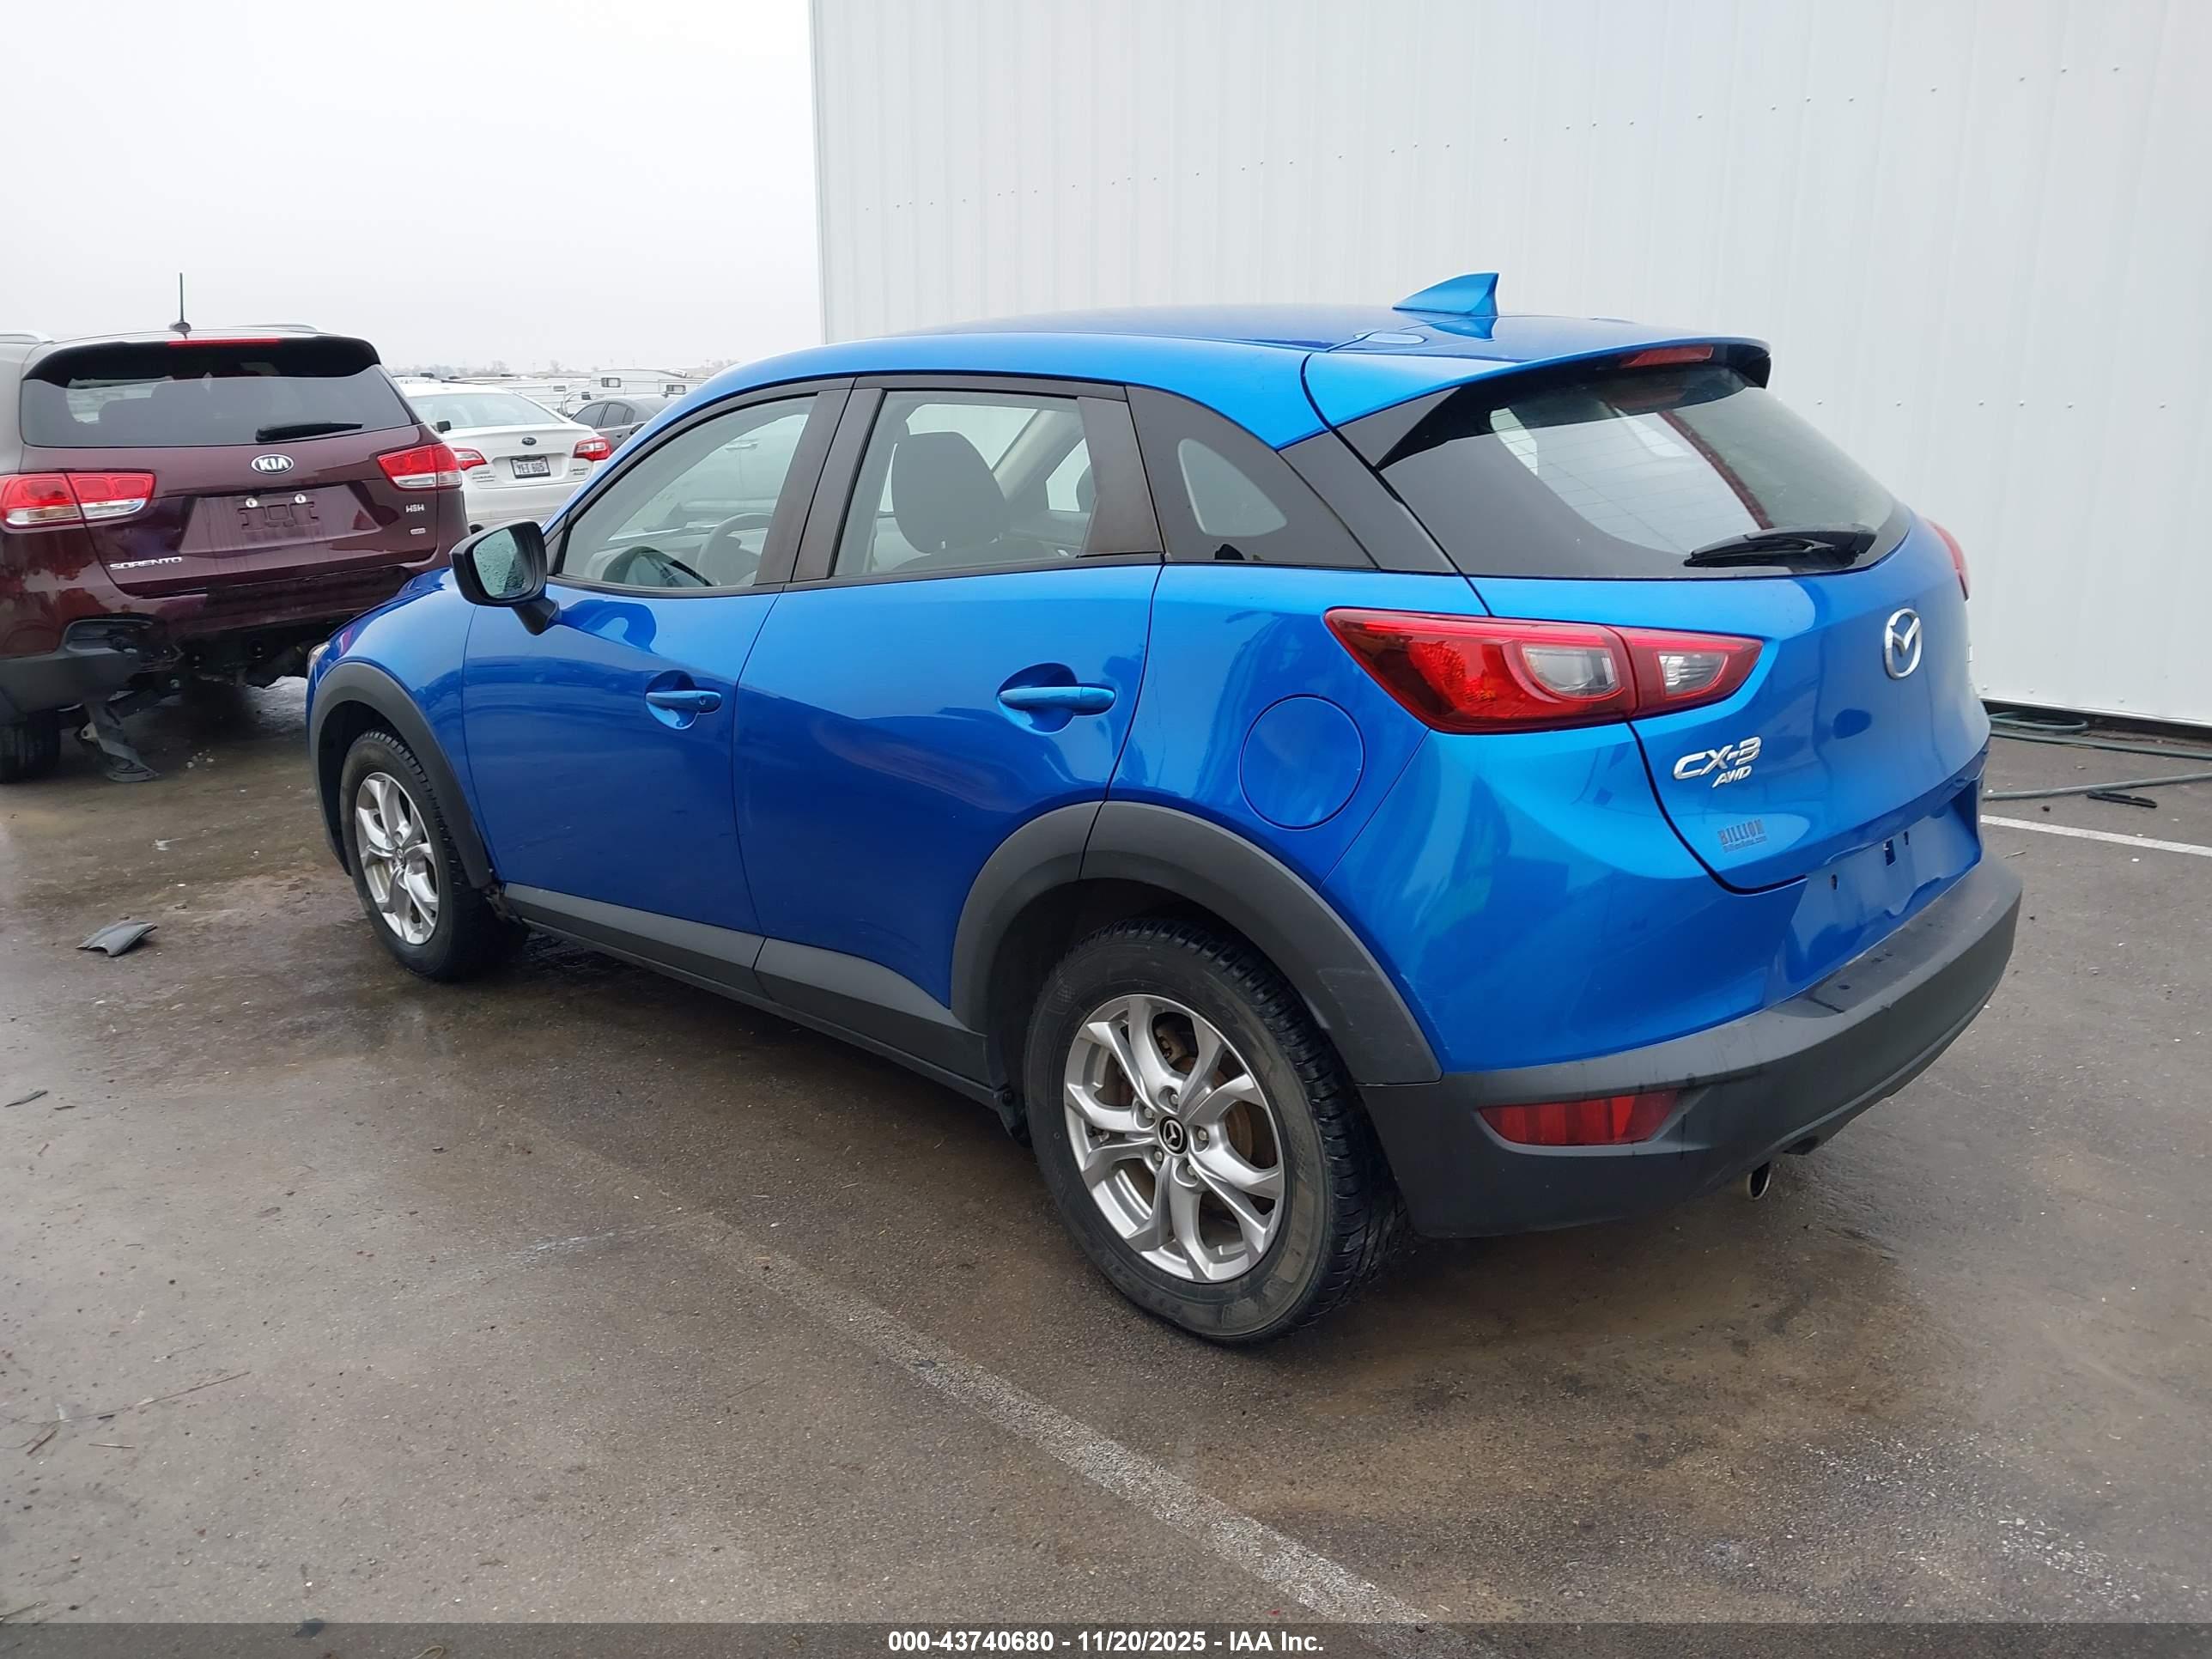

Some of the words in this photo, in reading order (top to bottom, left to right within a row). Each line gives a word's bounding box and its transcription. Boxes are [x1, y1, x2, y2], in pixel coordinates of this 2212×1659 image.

[258, 457, 289, 471] KIA
[109, 556, 183, 570] SORENTO
[1673, 736, 1762, 780] CX-3
[1711, 765, 1753, 788] AWD
[1717, 818, 1765, 845] BILLION
